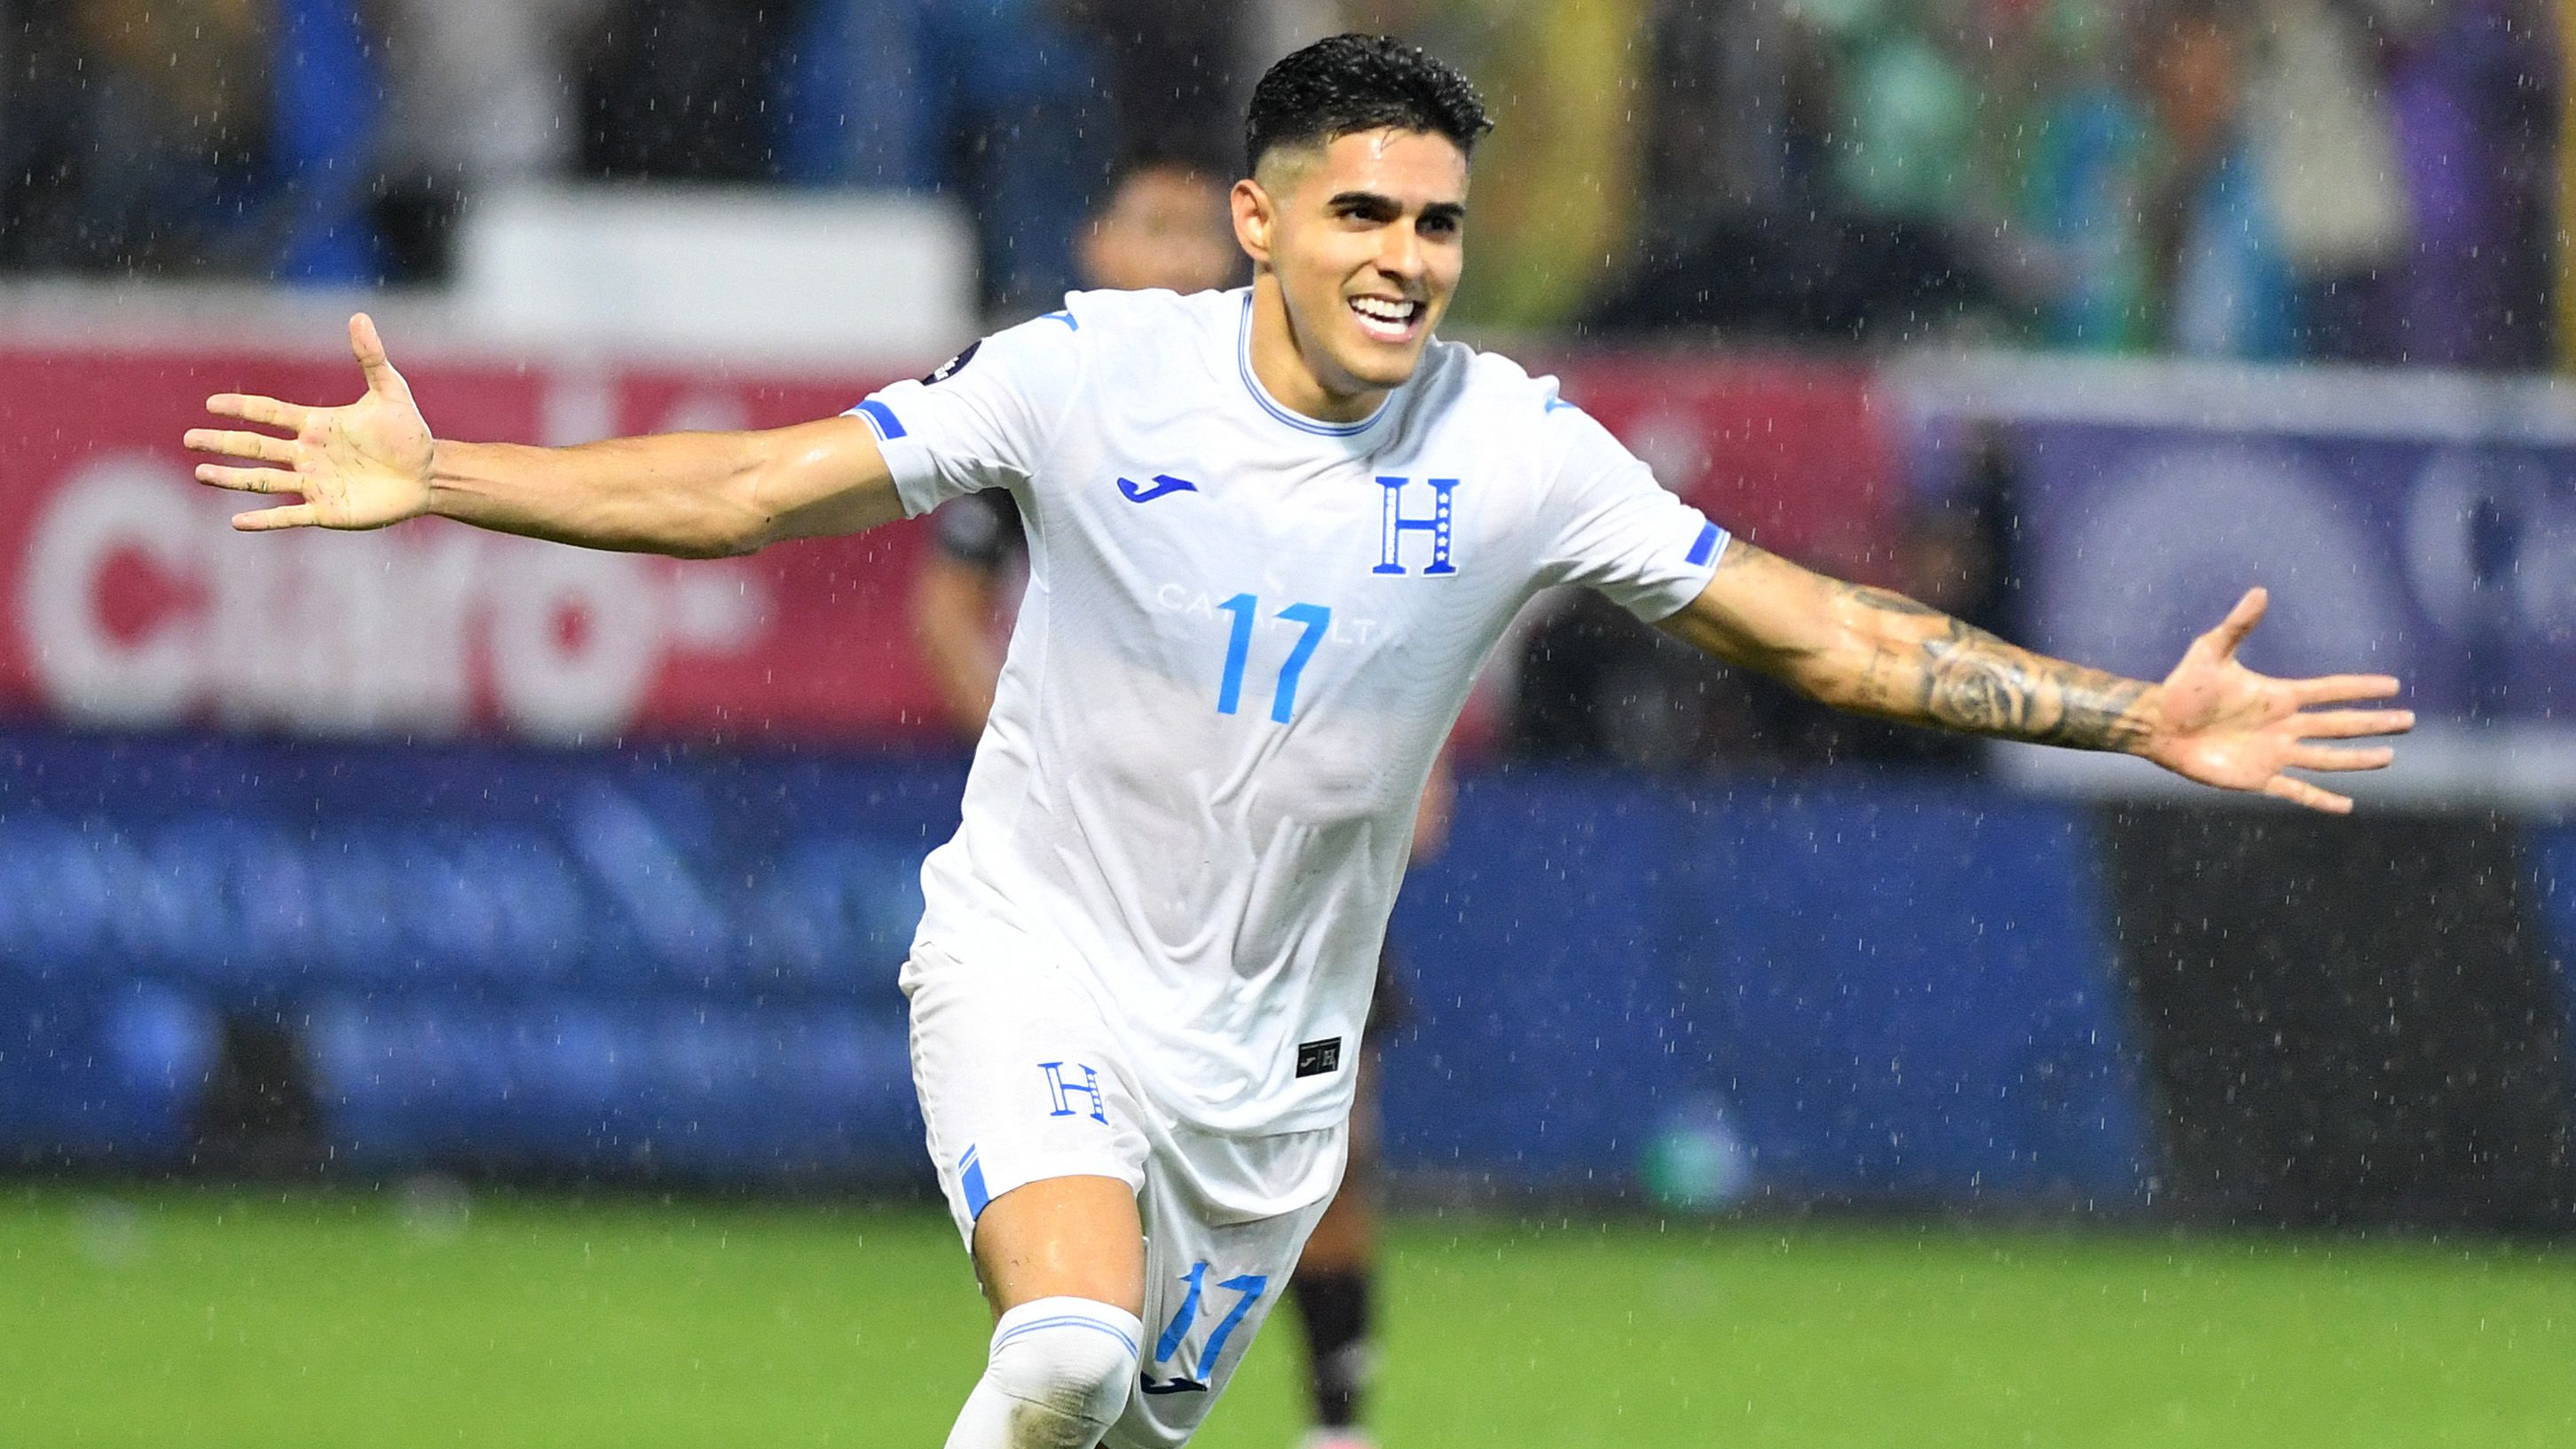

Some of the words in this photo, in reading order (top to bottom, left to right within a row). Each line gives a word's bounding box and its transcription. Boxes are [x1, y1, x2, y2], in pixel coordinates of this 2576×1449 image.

[1373, 475, 1461, 575] H
[1217, 593, 1332, 725] 17
[1037, 1061, 1109, 1125] H
[1155, 1262, 1268, 1382] 17
